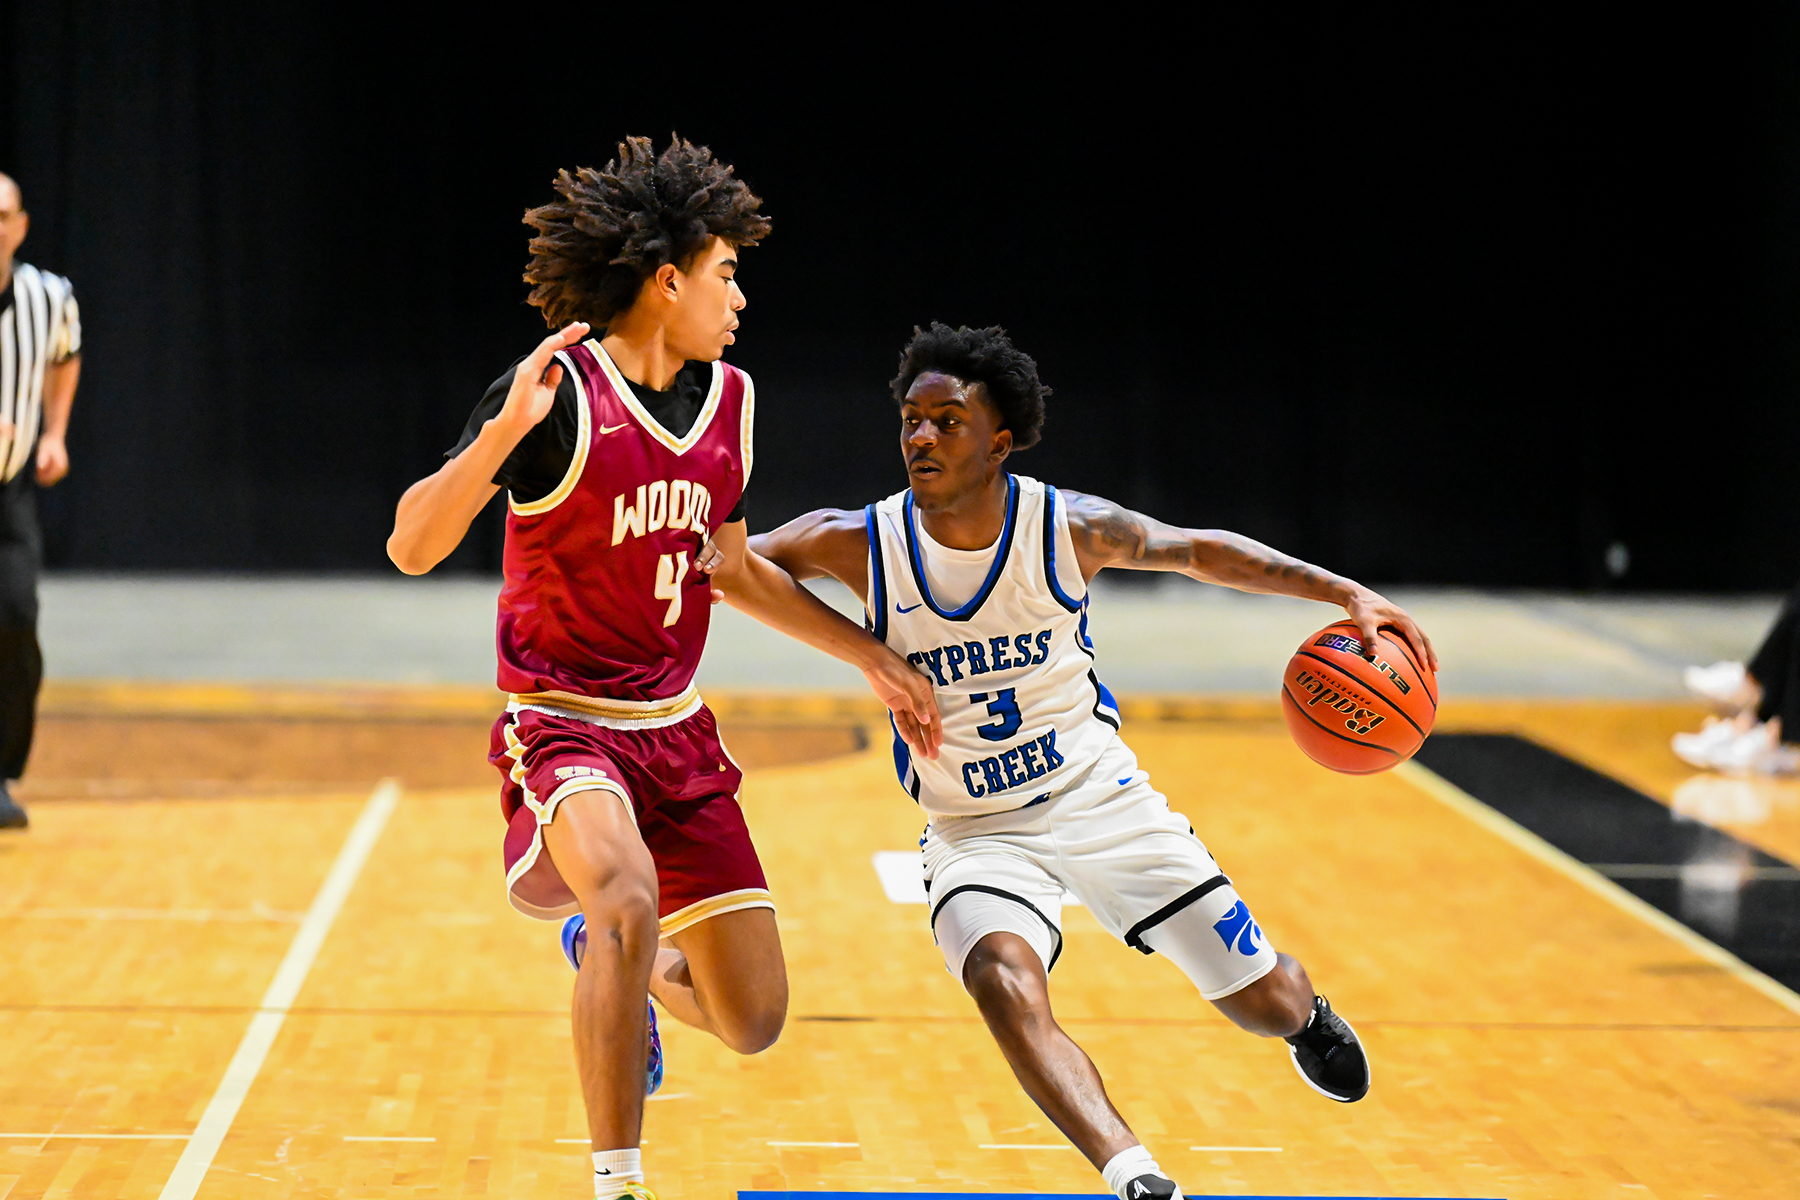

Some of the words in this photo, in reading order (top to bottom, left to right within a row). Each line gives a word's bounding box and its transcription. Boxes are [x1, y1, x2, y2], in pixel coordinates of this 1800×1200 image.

[654, 550, 689, 628] 4
[969, 687, 1023, 742] 3
[1296, 671, 1386, 735] Baden
[962, 728, 1065, 799] CREEK
